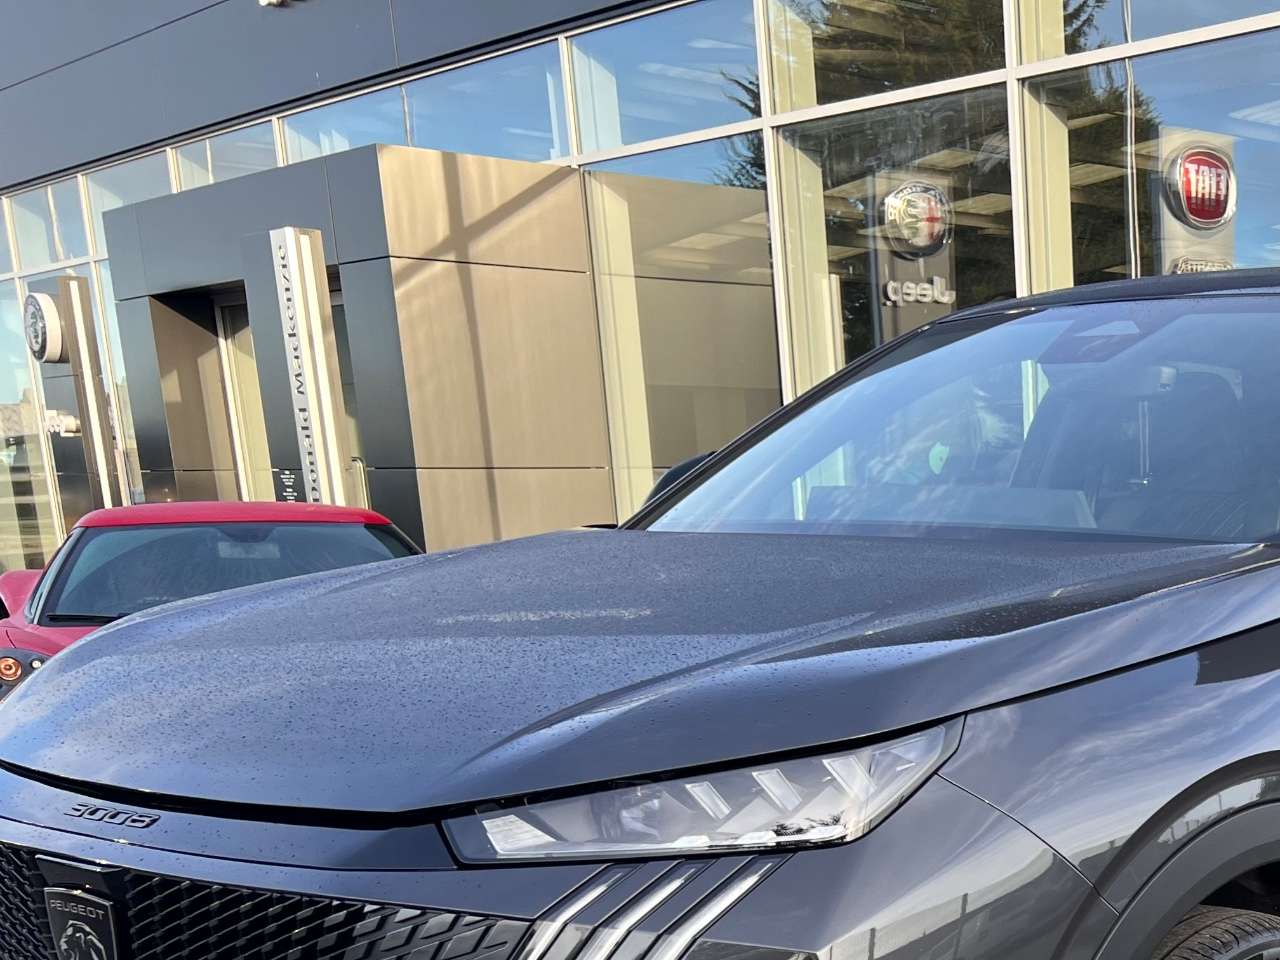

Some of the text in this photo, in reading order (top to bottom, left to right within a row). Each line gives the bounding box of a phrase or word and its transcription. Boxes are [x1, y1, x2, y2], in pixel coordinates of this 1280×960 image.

[278, 245, 320, 502] Donald Mackenzie
[65, 803, 160, 829] 3008
[50, 899, 105, 920] PEUGEOT
